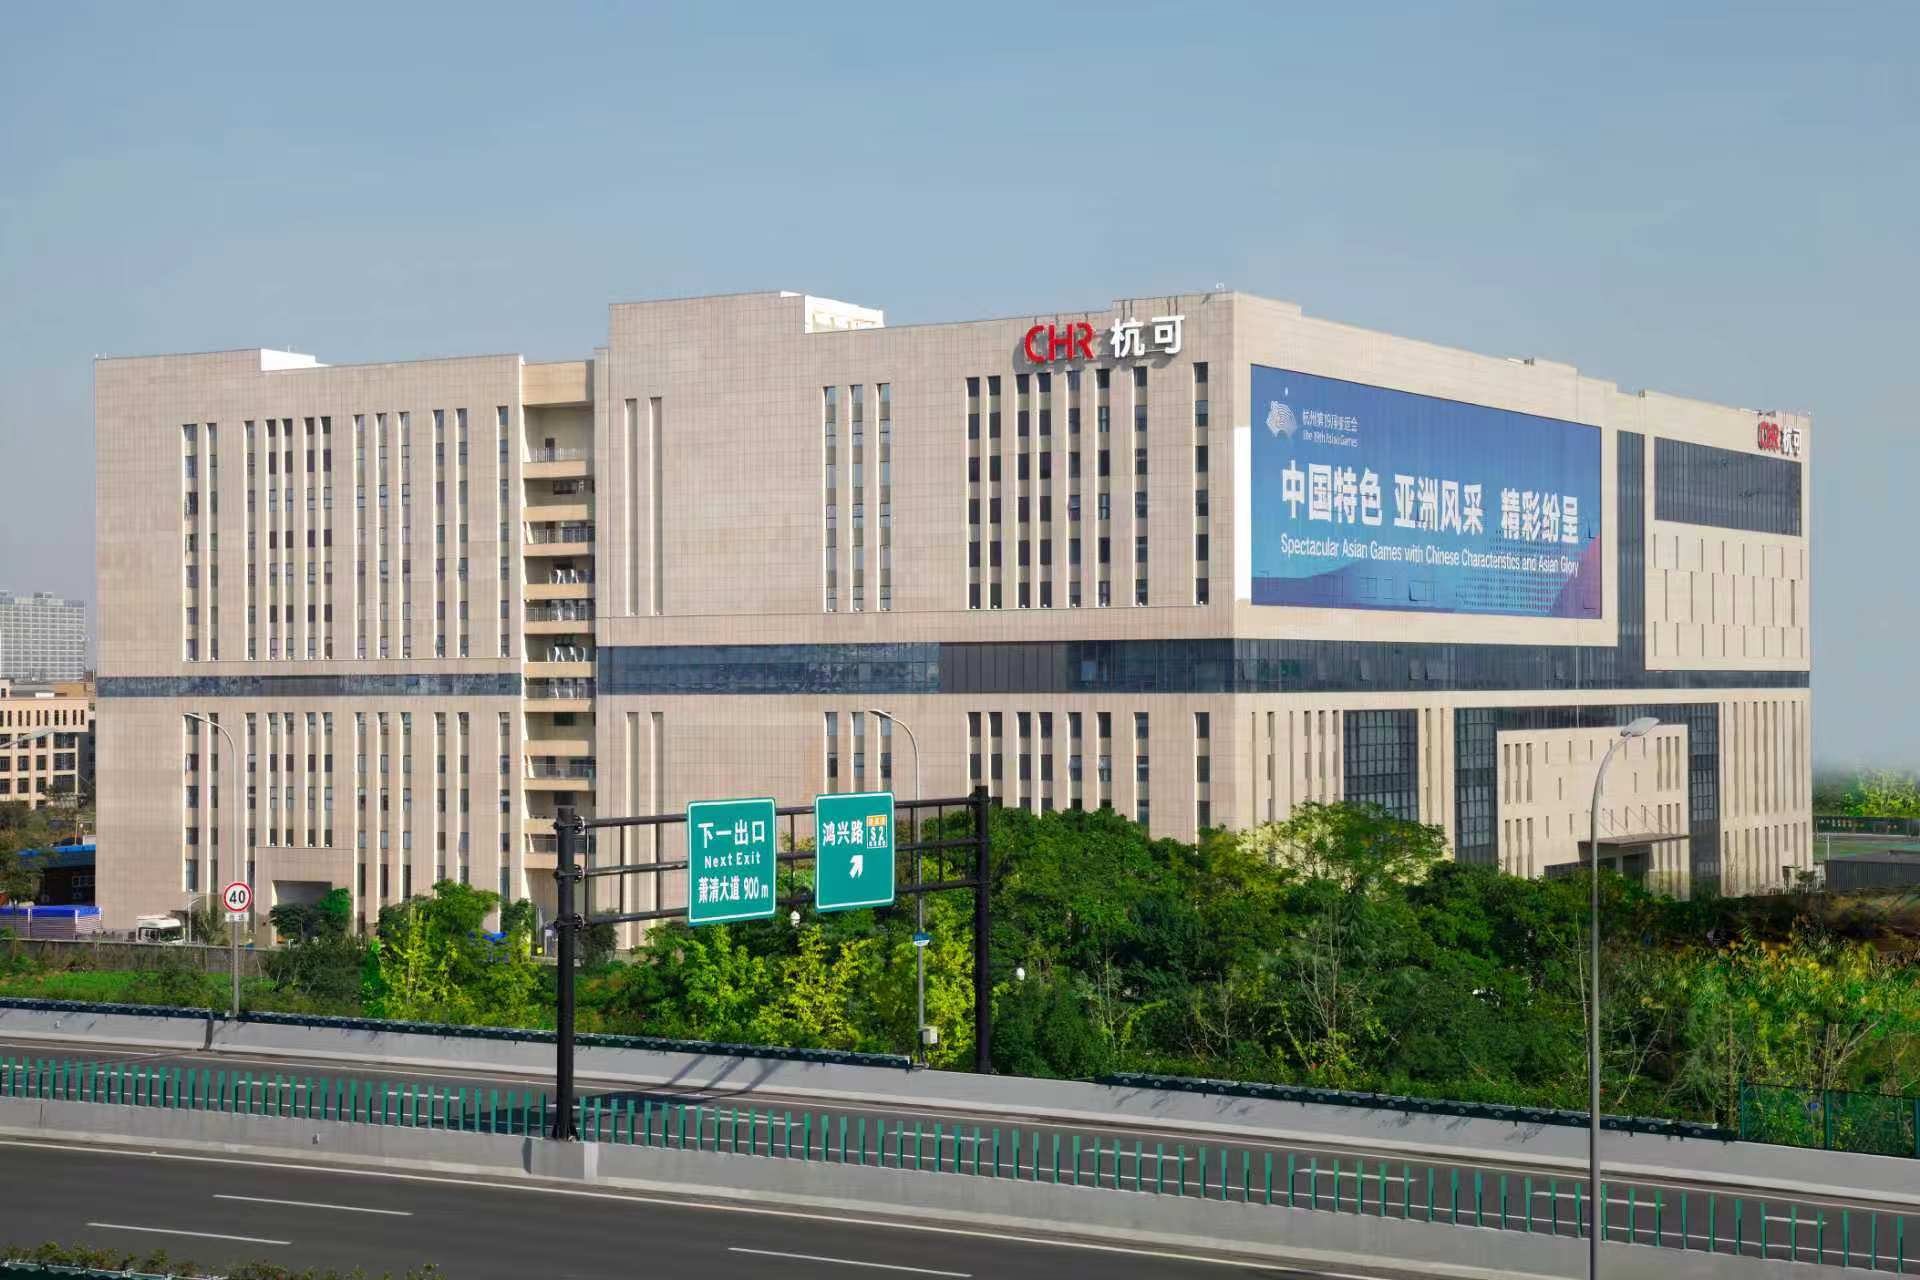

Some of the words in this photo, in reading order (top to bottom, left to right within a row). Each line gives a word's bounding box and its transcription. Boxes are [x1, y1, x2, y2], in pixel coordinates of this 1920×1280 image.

[1024, 321, 1095, 363] CHR
[1110, 315, 1185, 358] 杭可
[1281, 459, 1383, 526] 中国特色
[1393, 472, 1484, 536] 亚洲风采
[1501, 487, 1579, 545] 精彩纷呈
[1280, 533, 1339, 558] Spectacular
[1342, 538, 1368, 558] Asian
[1370, 540, 1402, 561] Games
[1404, 545, 1424, 563] with
[1425, 544, 1459, 566] Chinese
[1461, 548, 1520, 570] Characteristics
[1523, 557, 1537, 571] and
[1538, 555, 1559, 573] Asian
[1560, 556, 1579, 577] Glory
[697, 819, 766, 848] 下一出口
[822, 818, 864, 846] 鸿兴路
[704, 854, 733, 869] Next
[736, 851, 761, 866] Exit
[229, 890, 246, 904] 40
[698, 876, 740, 904] 萧清大道
[743, 877, 759, 900] 900
[760, 884, 769, 898] m
